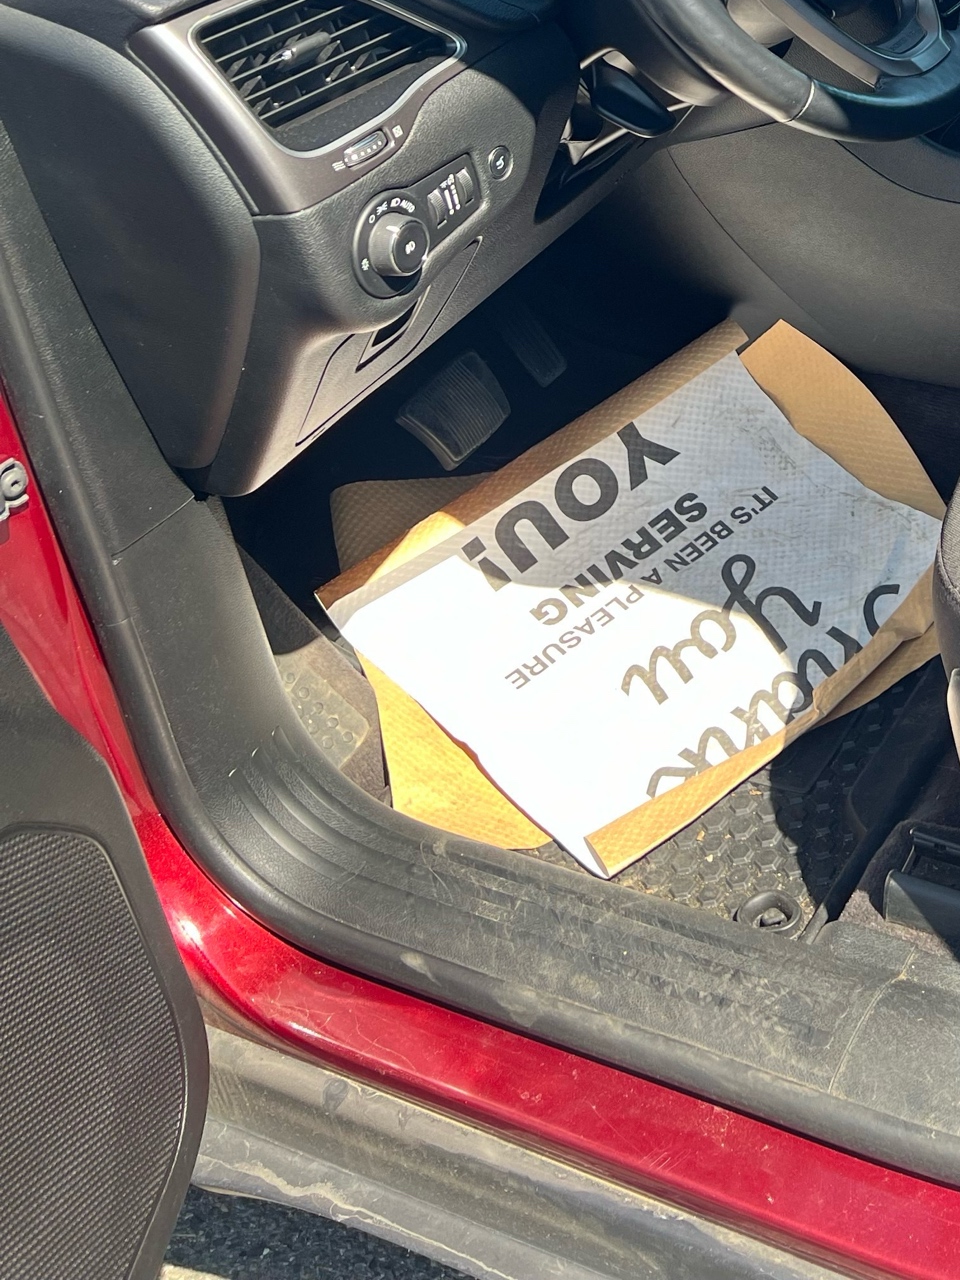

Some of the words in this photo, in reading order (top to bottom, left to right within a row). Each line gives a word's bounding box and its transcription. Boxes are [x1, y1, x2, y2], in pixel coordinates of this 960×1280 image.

[400, 199, 415, 213] AUTO
[461, 421, 681, 592] YOU!
[730, 486, 779, 524] IT'S
[529, 493, 707, 625] SERVING
[664, 520, 734, 572] BEEN
[640, 567, 663, 585] A
[505, 585, 645, 690] PLEASURE
